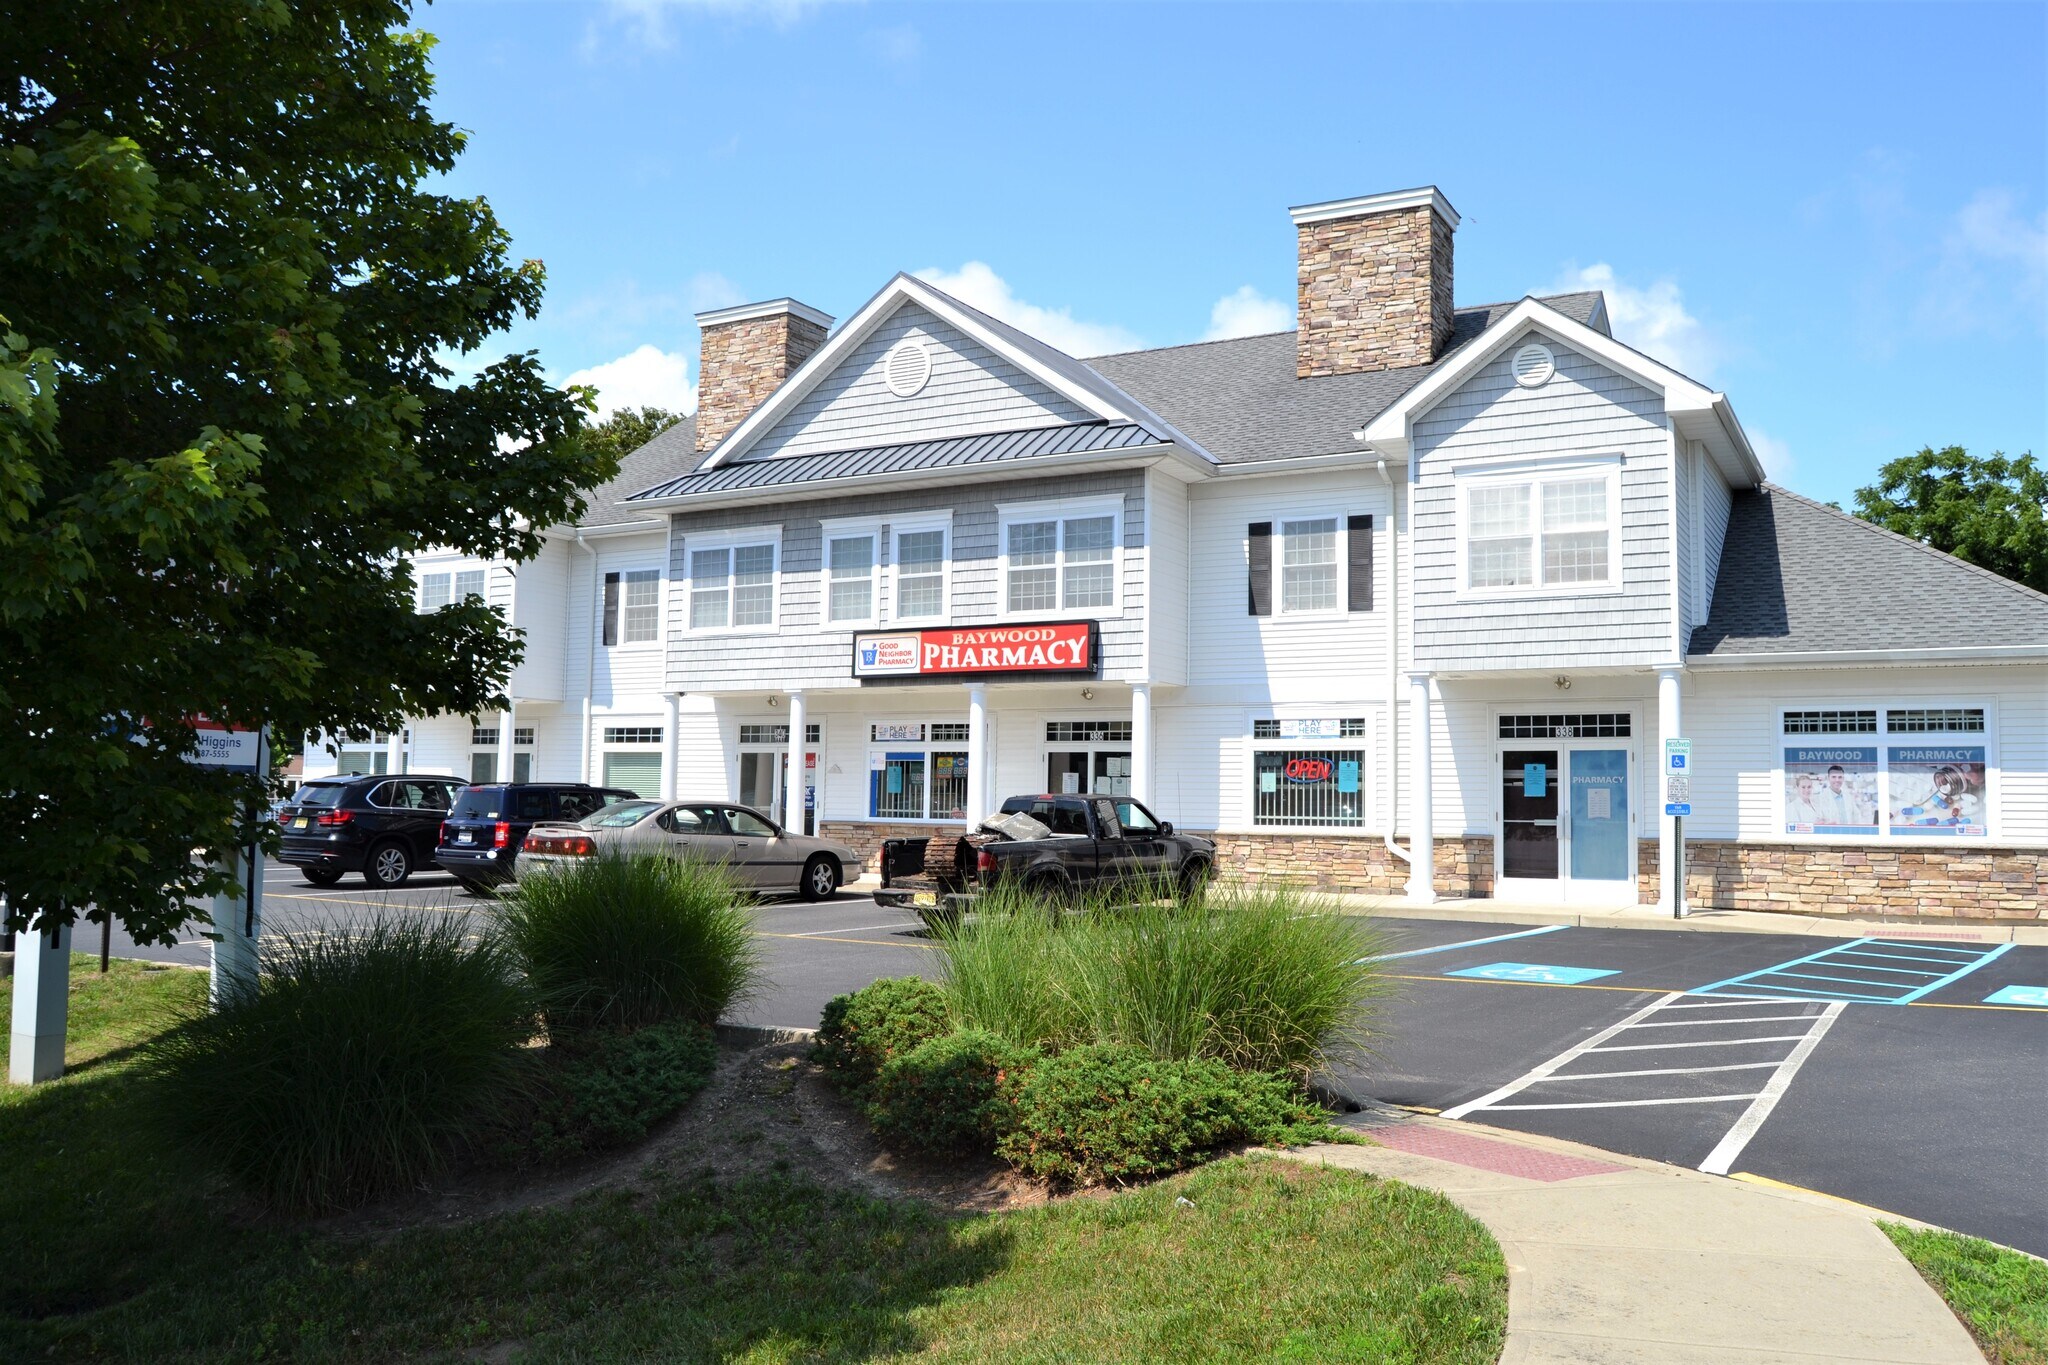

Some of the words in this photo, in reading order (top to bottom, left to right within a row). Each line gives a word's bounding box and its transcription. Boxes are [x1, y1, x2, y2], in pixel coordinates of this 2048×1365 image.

[952, 629, 1056, 645] BAYWOOD
[879, 642, 899, 650] GOOD
[879, 650, 912, 658] NEIGHBOR
[923, 636, 1087, 669] PHARMACY
[879, 658, 914, 666] PHARMACY
[1299, 726, 1321, 734] HERE
[1556, 727, 1573, 737] 338
[1090, 732, 1104, 740] 336
[201, 736, 241, 749] Higgins
[1799, 751, 1862, 760] BAYWOOD
[1900, 750, 1972, 760] PHARMACY
[1286, 760, 1330, 779] OPEN
[1572, 776, 1624, 784] PHARMACY
